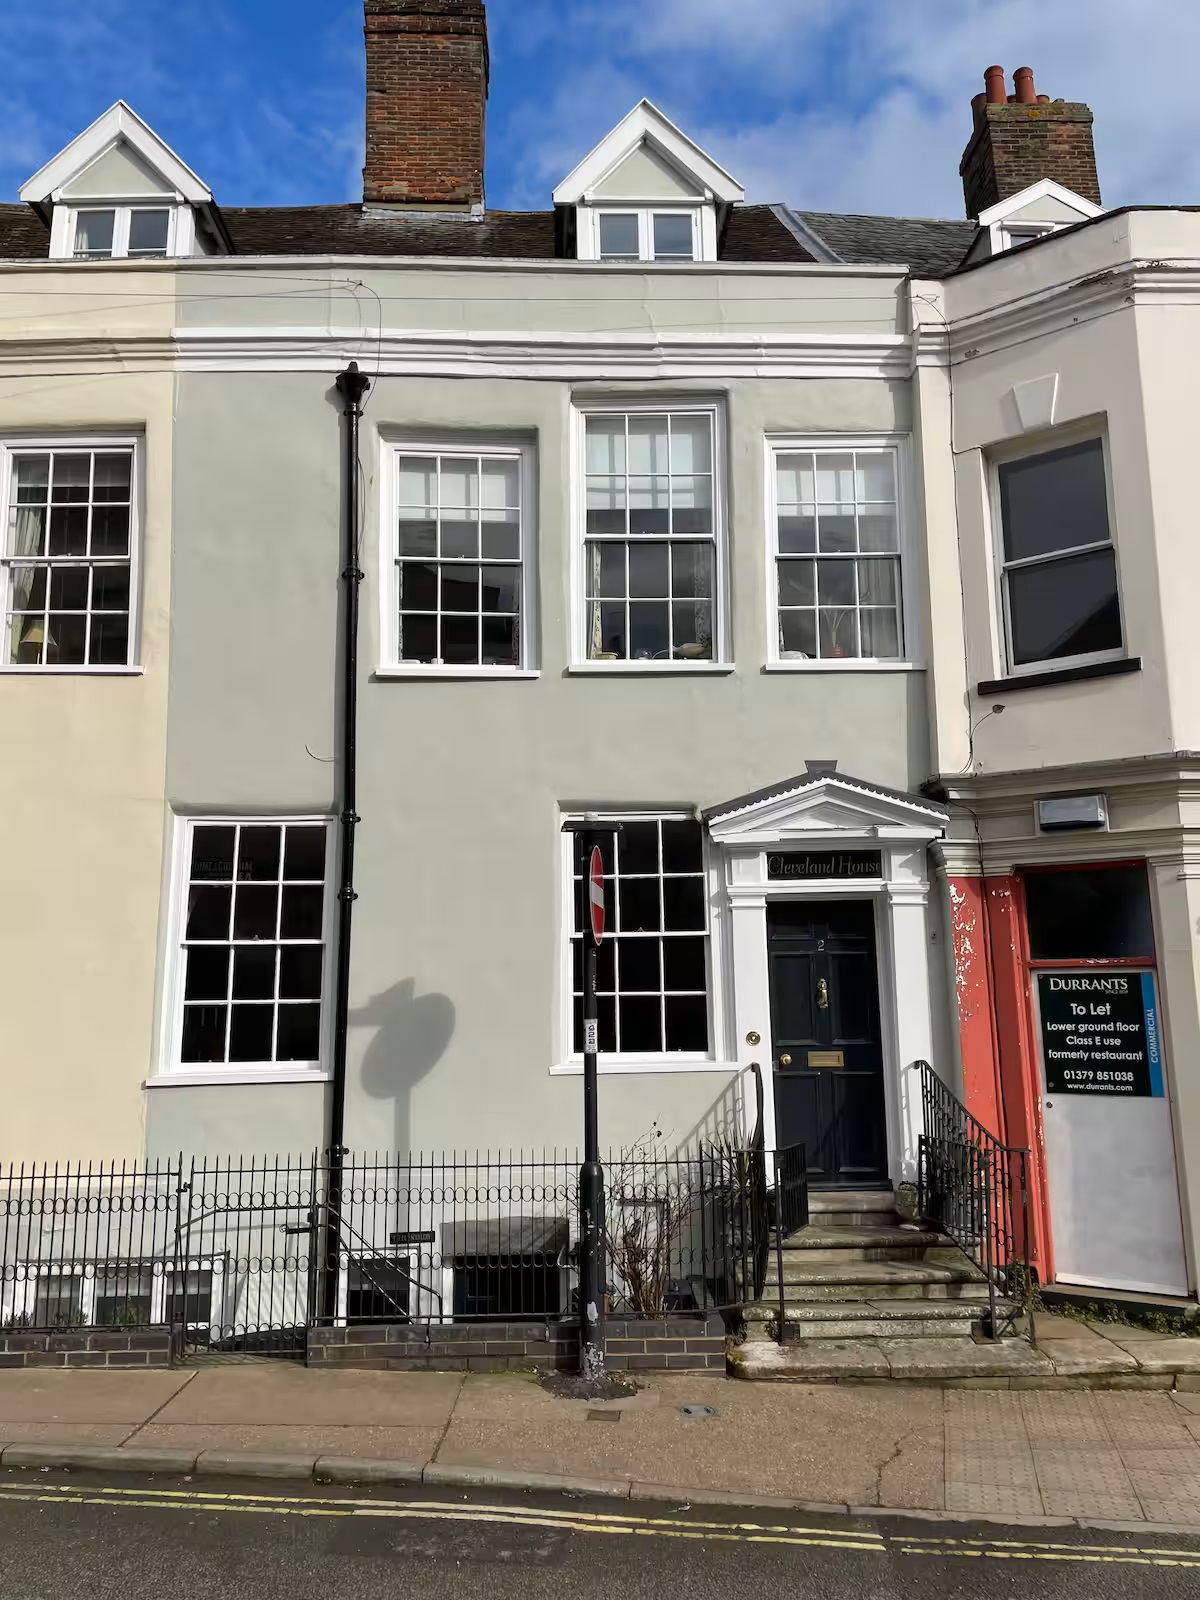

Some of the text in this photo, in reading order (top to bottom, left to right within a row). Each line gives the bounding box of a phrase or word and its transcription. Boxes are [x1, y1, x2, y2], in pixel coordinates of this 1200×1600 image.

[768, 855, 880, 875] Cleveland House
[817, 939, 825, 951] 2
[1049, 978, 1128, 991] DURRANTS
[1070, 1003, 1111, 1015] To Let
[1047, 1022, 1140, 1033] Lower ground floor
[1066, 1036, 1093, 1045] Class
[1095, 1036, 1101, 1045] E
[1146, 1008, 1158, 1063] COMMERCIAL
[1048, 1049, 1143, 1060] formerly restaurant
[1063, 1070, 1134, 1081] 01379 851038
[1067, 1083, 1133, 1091] www.durrants.com
